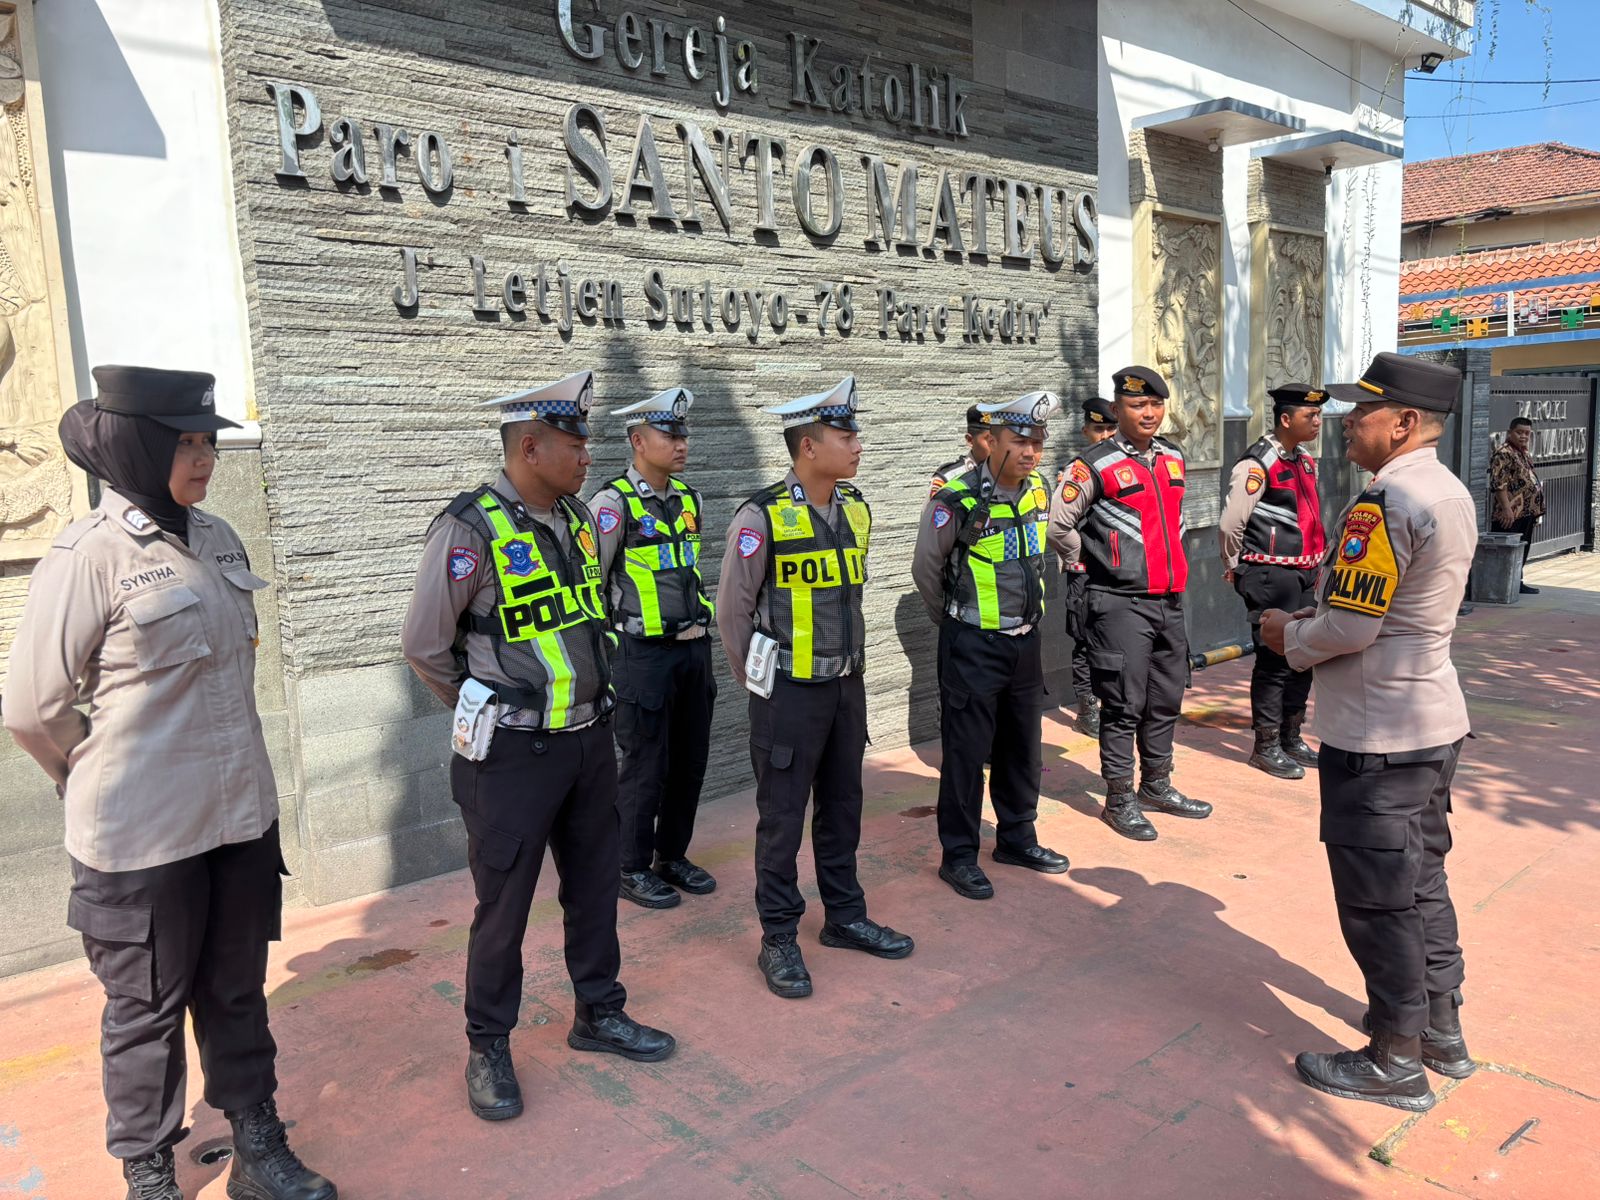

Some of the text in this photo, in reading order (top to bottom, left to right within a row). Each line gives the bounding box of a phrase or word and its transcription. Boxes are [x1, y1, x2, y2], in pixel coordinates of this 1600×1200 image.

[557, 0, 970, 137] Gereja Katolik
[563, 103, 845, 238] SANTO
[861, 156, 1099, 266] MATEUS
[470, 255, 625, 332] Letjen
[876, 287, 949, 336] Pare
[1536, 427, 1587, 458] MATEUS
[120, 565, 176, 591] SYNTHA
